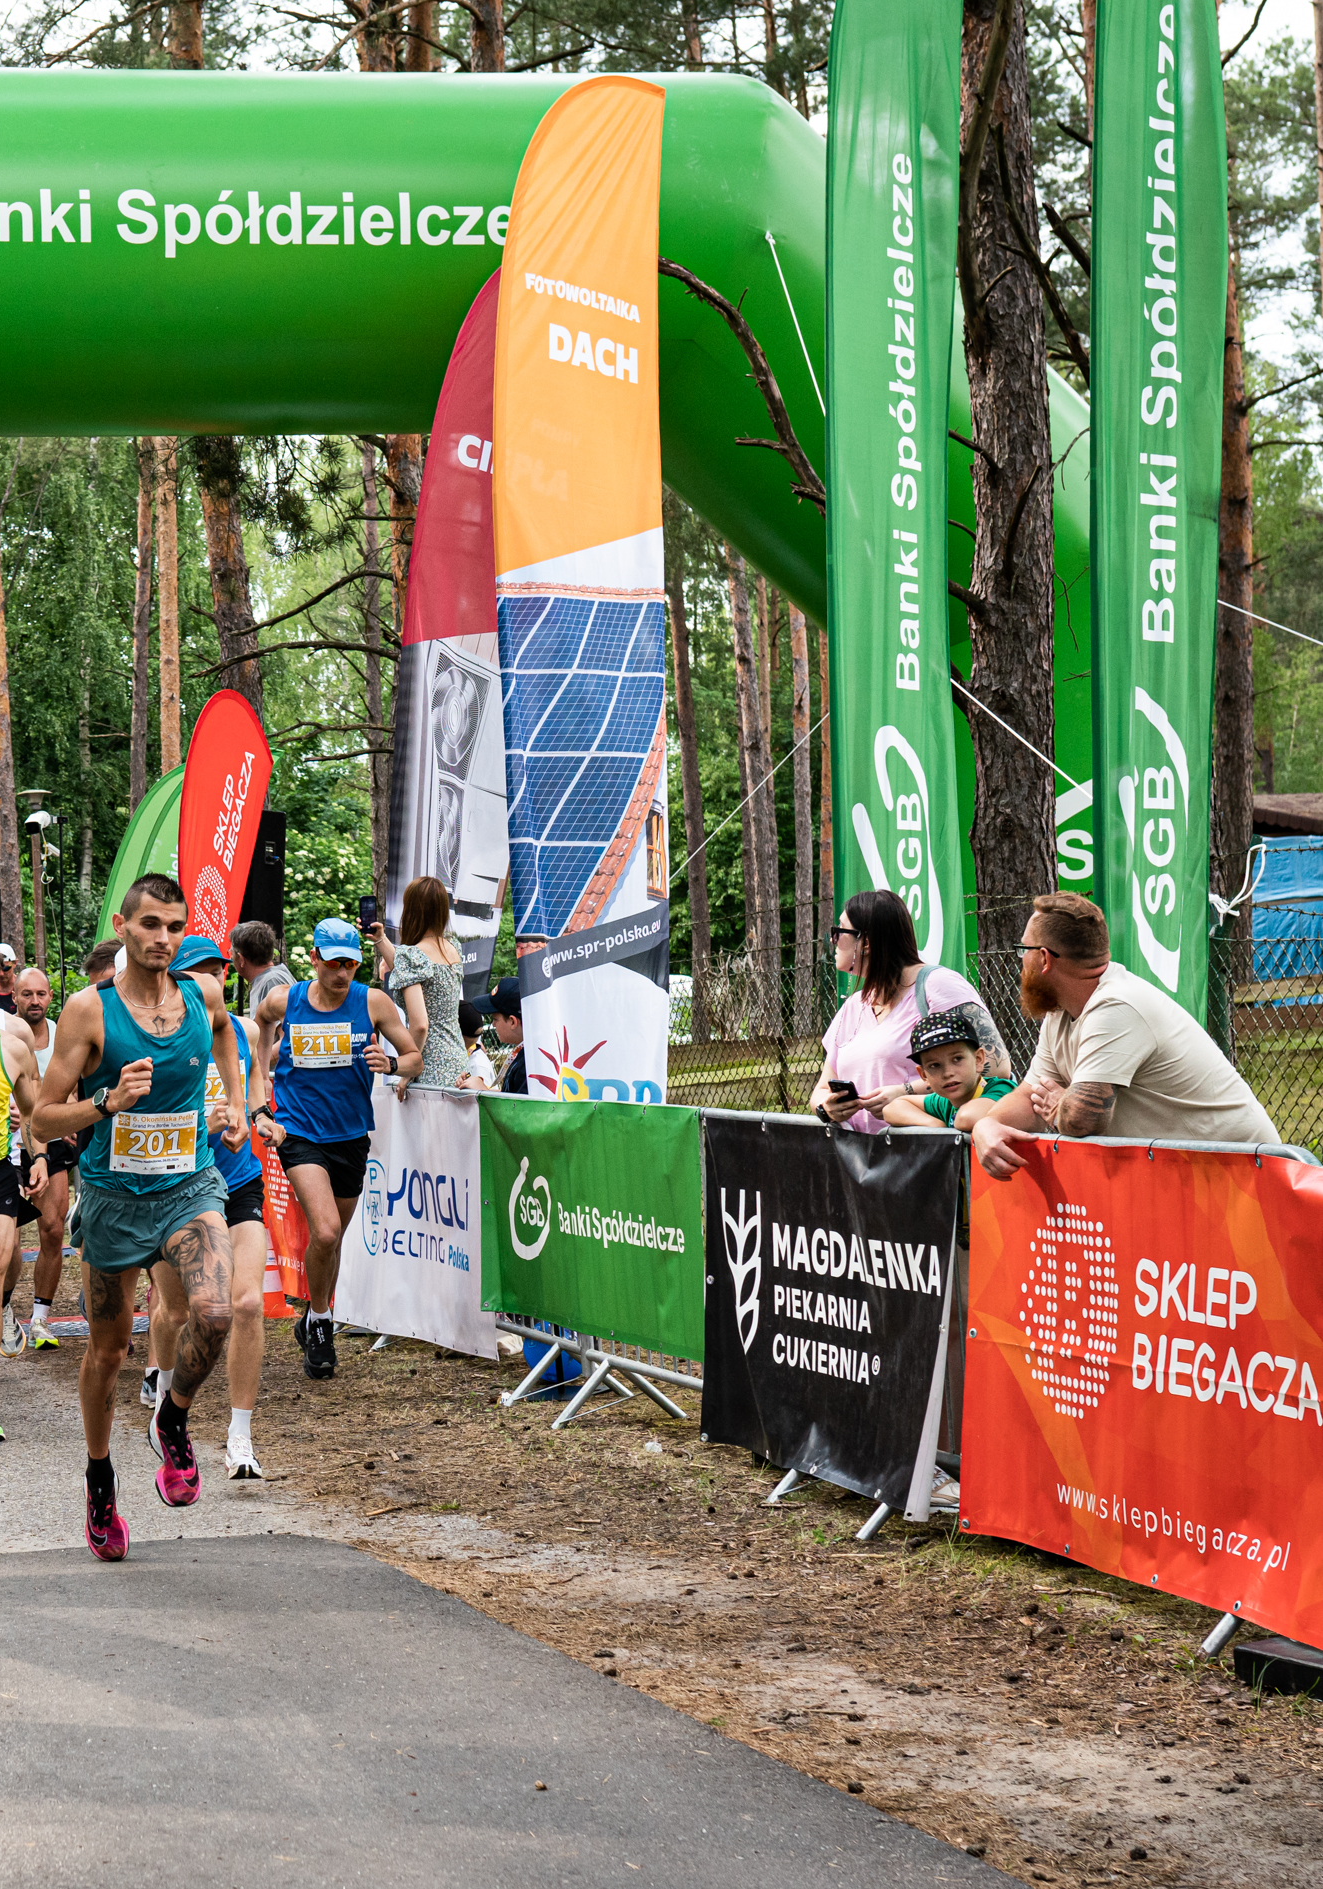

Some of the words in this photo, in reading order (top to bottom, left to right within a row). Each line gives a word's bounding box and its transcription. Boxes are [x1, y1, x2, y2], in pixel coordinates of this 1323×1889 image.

[117, 189, 510, 259] Spółdzielcze
[525, 273, 641, 324] FOTOWOLTAIKA
[887, 152, 923, 512] Spółdzielcze
[548, 323, 640, 385] DACH
[1140, 453, 1178, 644] Banki
[892, 528, 921, 692] Banki
[213, 773, 235, 857] SKLEP
[222, 750, 256, 873] BIEGACZA
[1142, 765, 1177, 917] SGB
[896, 792, 923, 921] SGB
[301, 1036, 341, 1055] 211
[351, 1033, 368, 1043] RATON
[205, 1077, 227, 1101] 22
[127, 1130, 182, 1157] 201
[519, 1193, 545, 1228] SGB
[558, 1201, 591, 1239] Banki
[592, 1207, 686, 1254] Spółdzielcze
[447, 1244, 470, 1272] Polska
[772, 1222, 942, 1297] MAGDALENKA
[1134, 1257, 1258, 1331] SKLEP
[774, 1283, 872, 1335] PIEKARNIA
[1132, 1332, 1323, 1427] BIEGACZA
[1057, 1483, 1292, 1573] www.sklepbiegacza.pl
